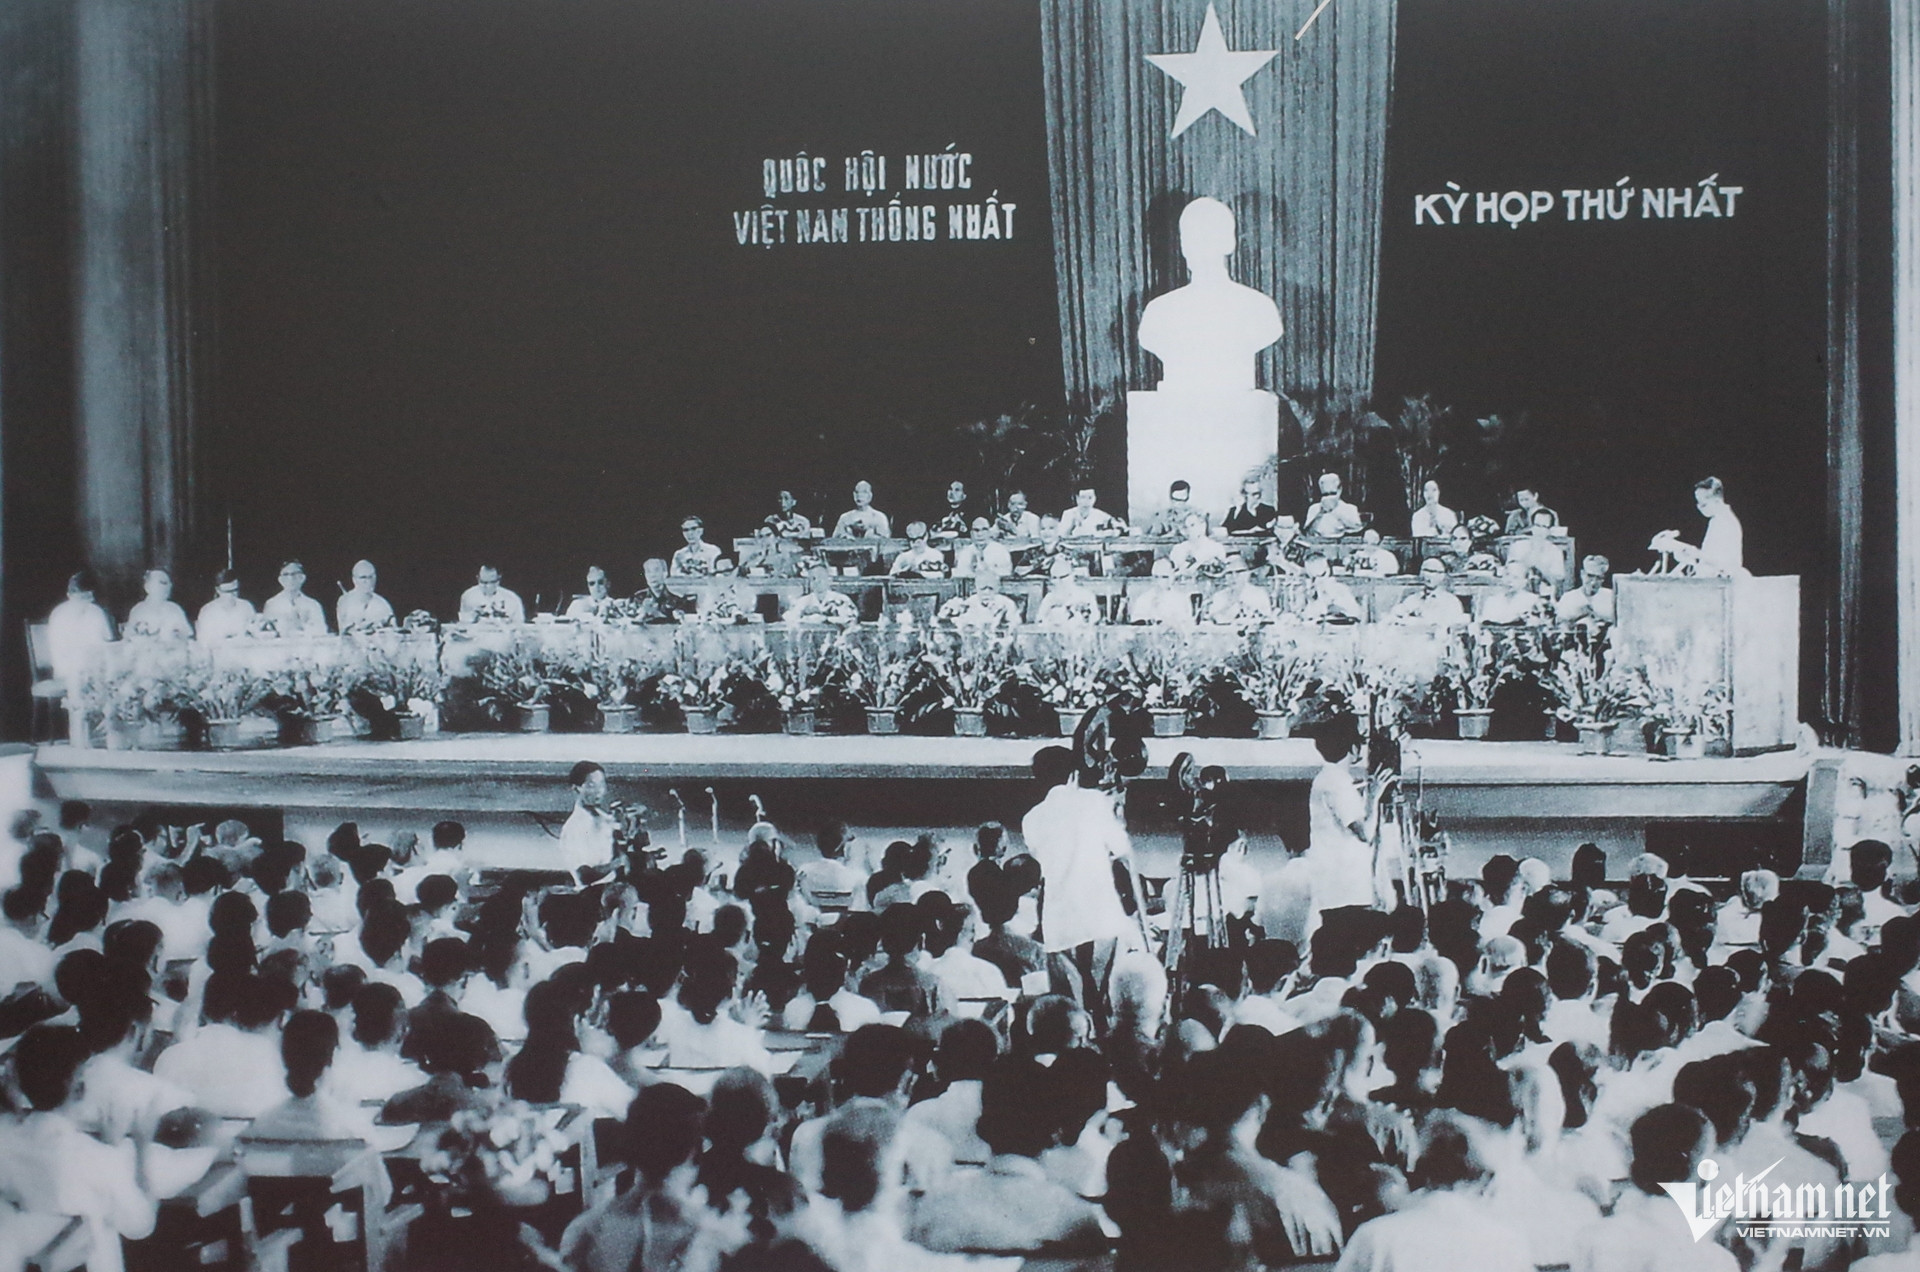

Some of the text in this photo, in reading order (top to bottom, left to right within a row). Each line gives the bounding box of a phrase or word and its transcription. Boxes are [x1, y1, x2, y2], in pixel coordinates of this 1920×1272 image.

[844, 149, 887, 197] HỘI
[905, 142, 972, 190] NƯỚC
[733, 188, 1017, 249] VIỆT NAM THỐNG NHẤT
[1414, 172, 1744, 230] KỲ HỌP THỨ NHẤT
